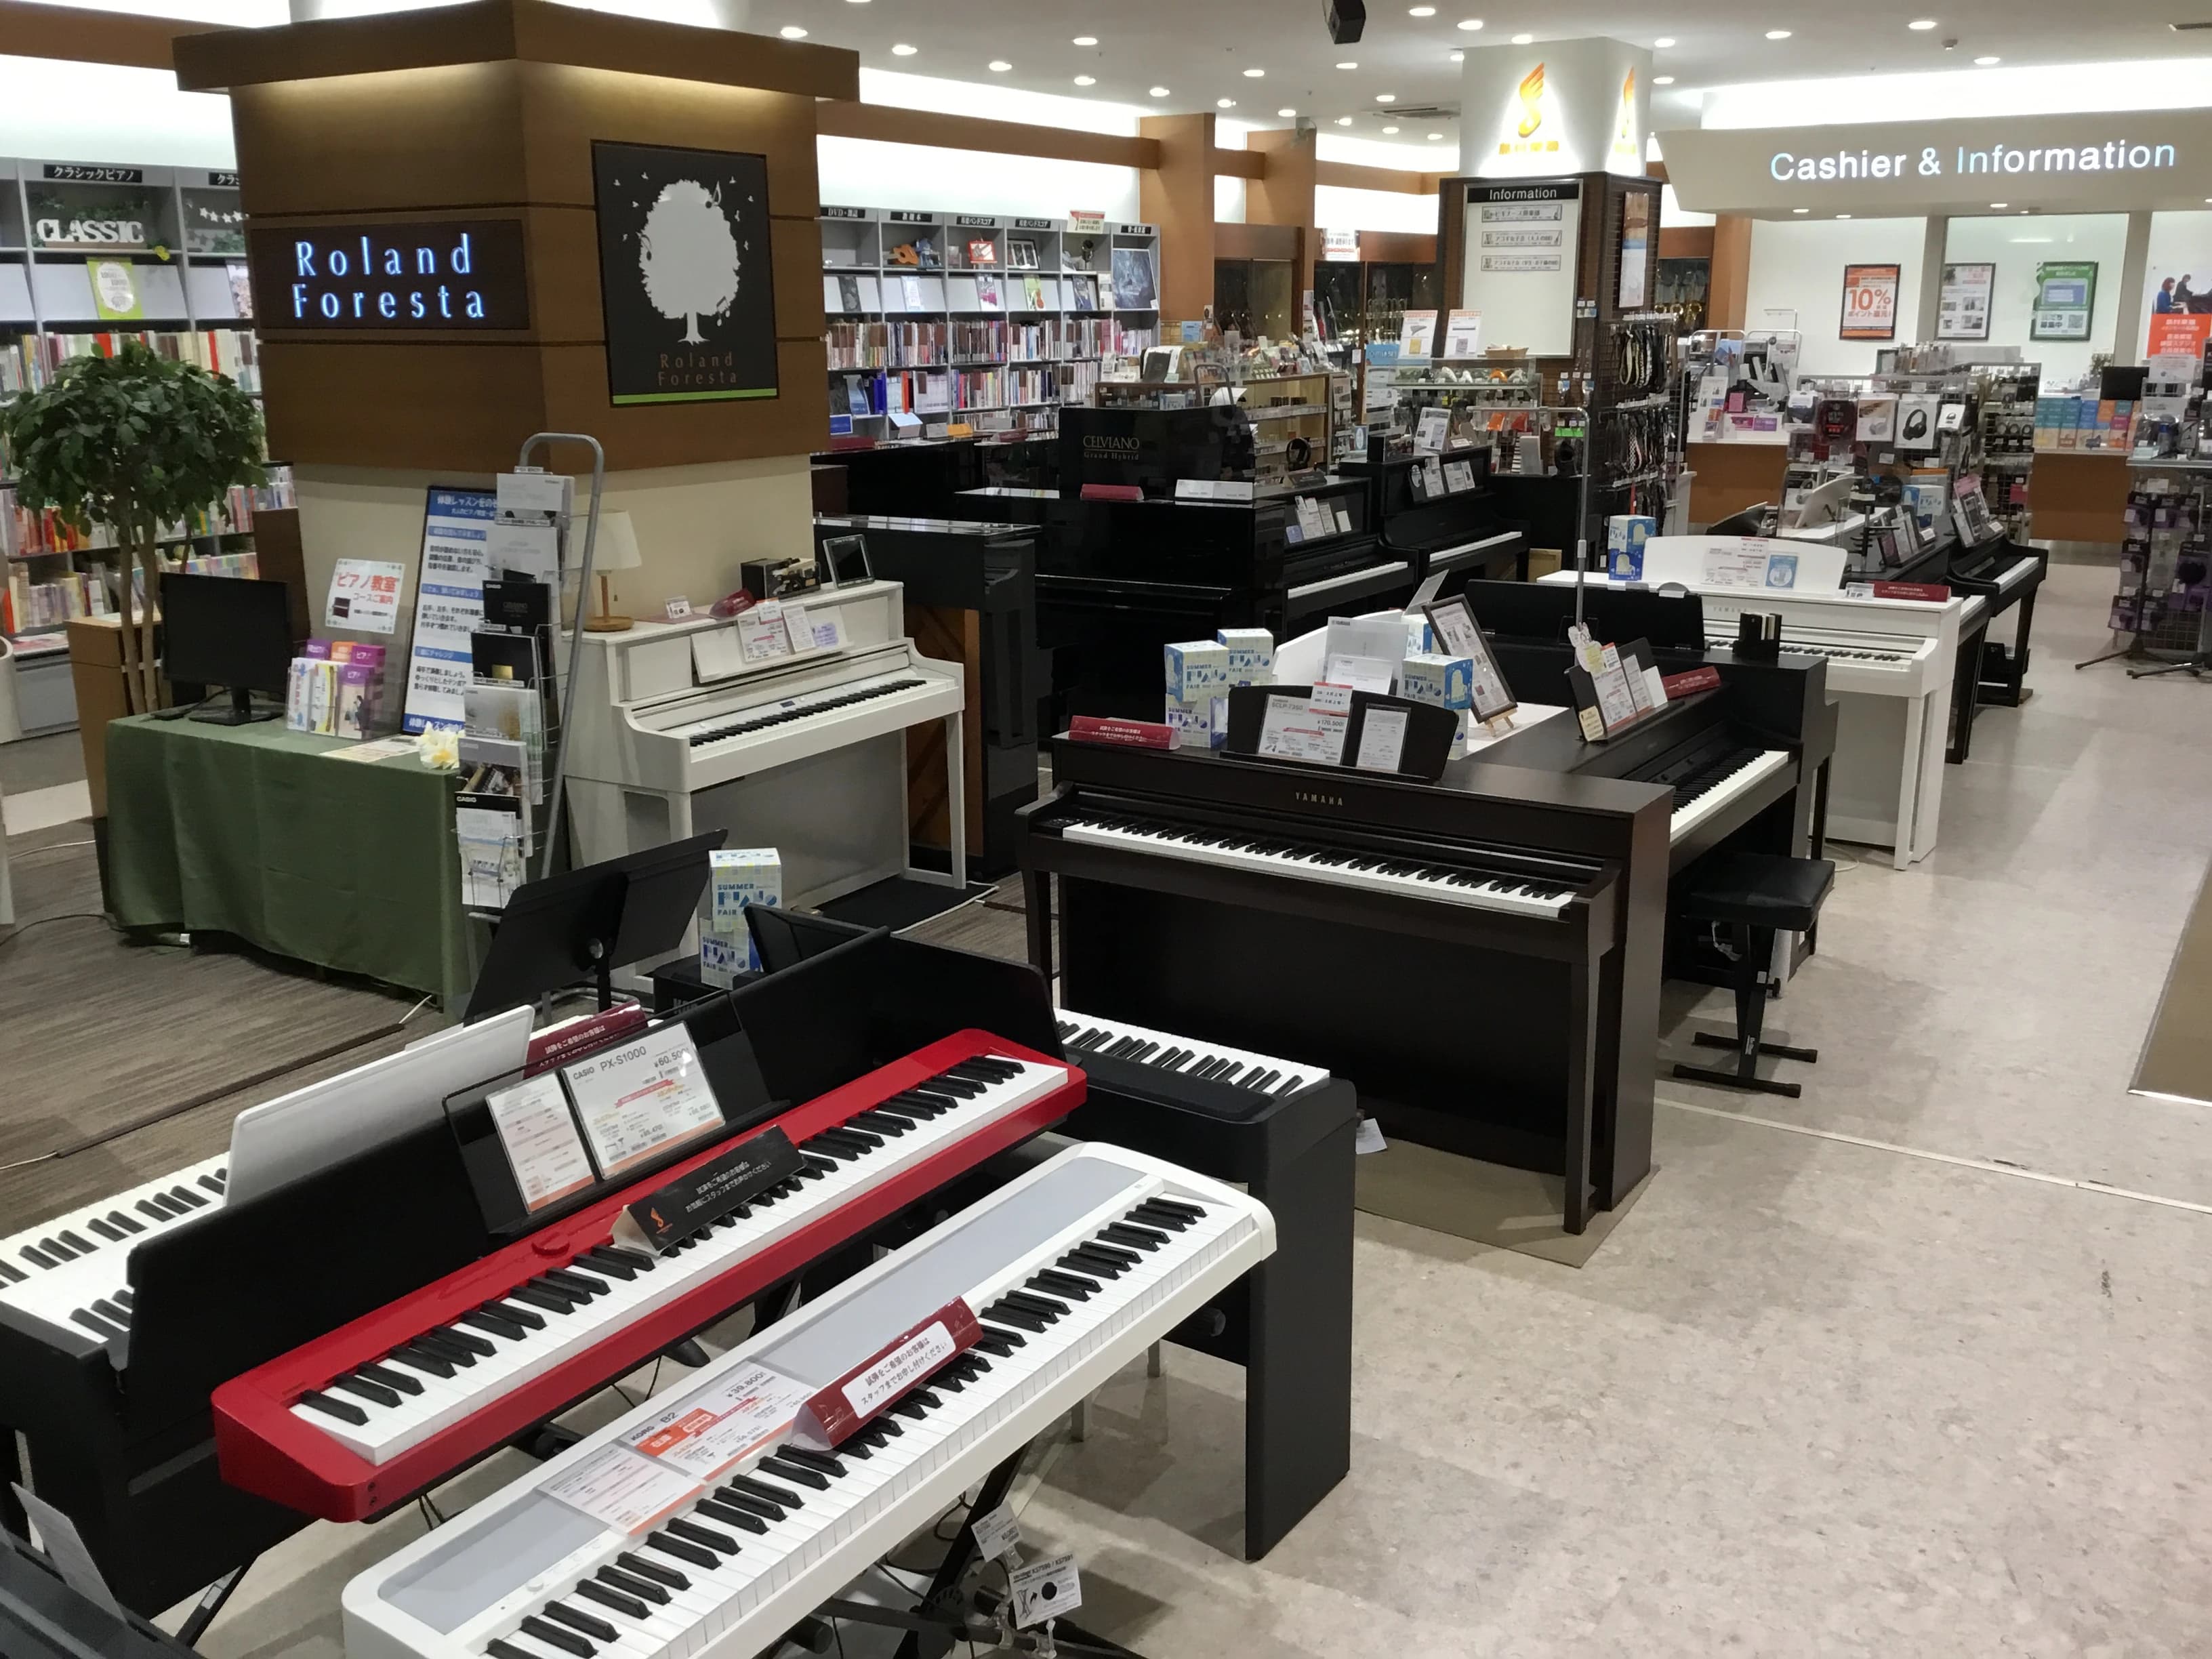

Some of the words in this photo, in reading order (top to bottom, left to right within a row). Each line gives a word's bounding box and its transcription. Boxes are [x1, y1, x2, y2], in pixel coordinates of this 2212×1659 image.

[1771, 150, 1906, 180] Cashier
[1919, 147, 1941, 176] &
[1957, 140, 2175, 173] Information
[54, 166, 135, 181] クラシックピアノ
[1490, 187, 1557, 201] Information
[36, 218, 144, 243] CLASSIC
[295, 232, 471, 276] Roland
[291, 283, 485, 318] Foresta
[1849, 289, 1891, 310] 10%
[659, 352, 733, 369] Roland
[658, 371, 737, 386] Foresta
[1083, 435, 1140, 450] CELVIANO
[337, 572, 398, 593] ピアノ教室
[1295, 792, 1343, 806] YAMAHA
[702, 937, 728, 948] SUMMER
[703, 961, 716, 970] FAIR
[573, 1066, 595, 1081] CASIO
[599, 1045, 647, 1071] PX-S1000
[865, 1337, 930, 1387] 試弾をご希望のお客様は
[861, 1342, 947, 1405] スタッフまでお申し付けください
[630, 1425, 655, 1441] KORG
[660, 1412, 678, 1424] B2
